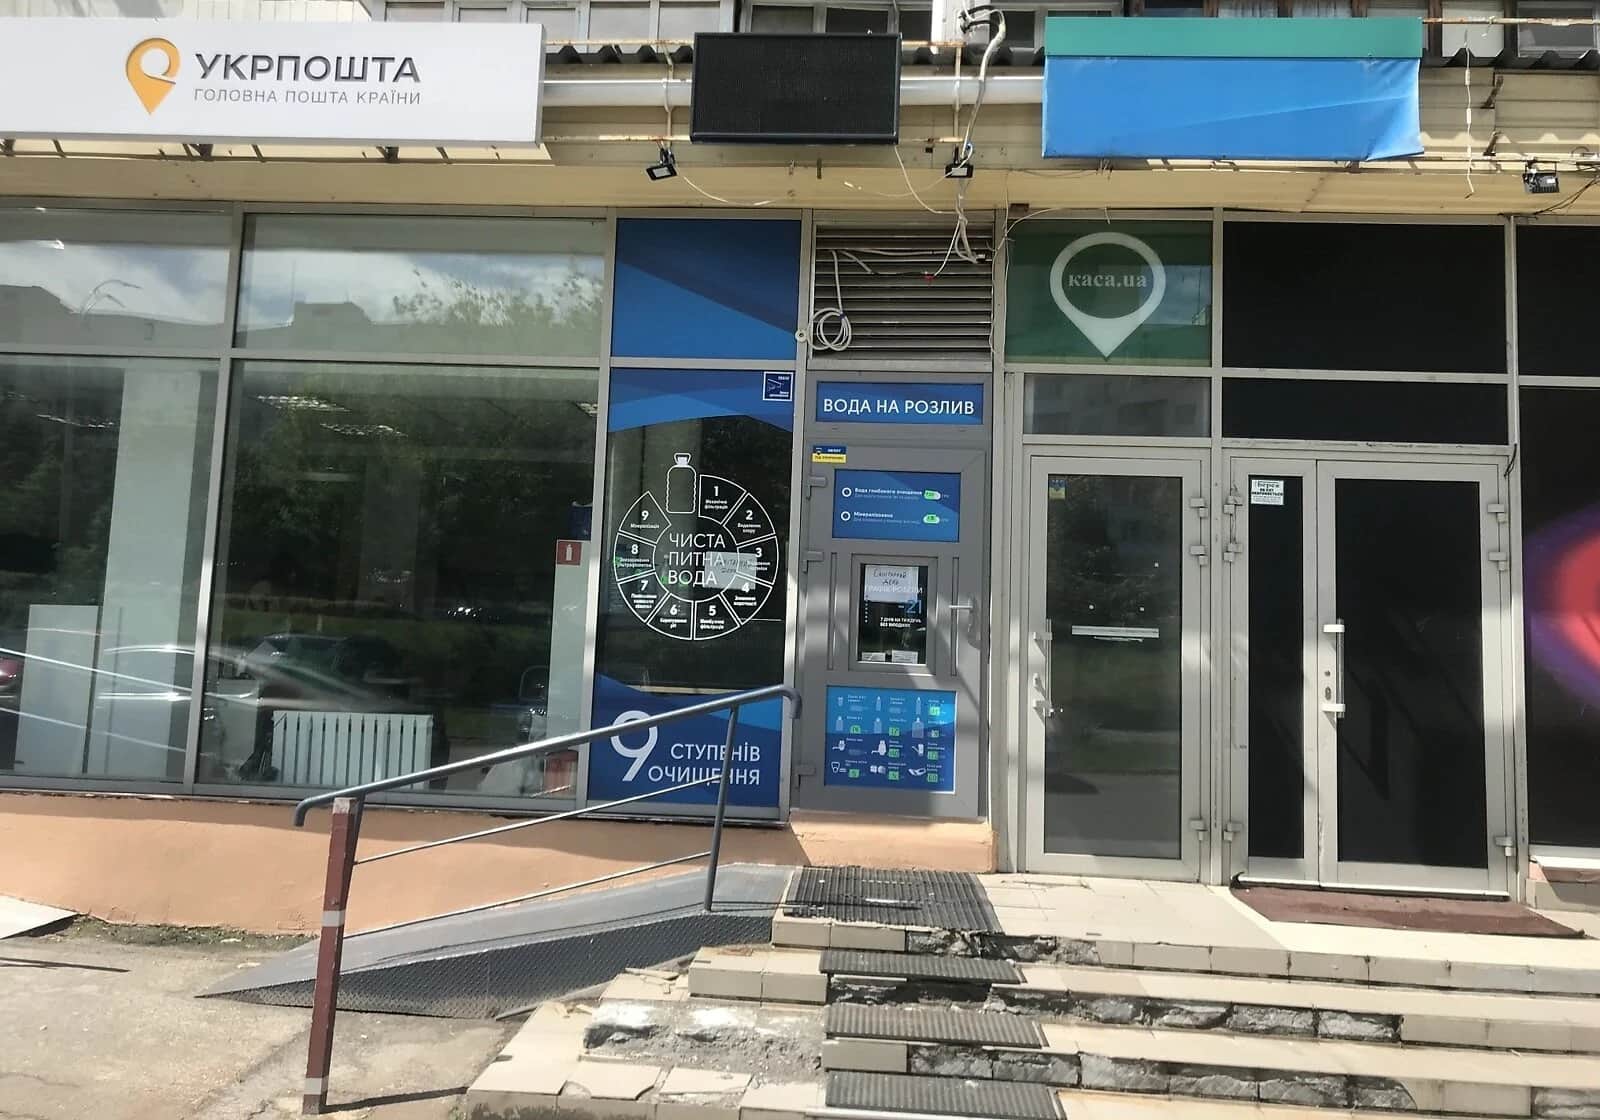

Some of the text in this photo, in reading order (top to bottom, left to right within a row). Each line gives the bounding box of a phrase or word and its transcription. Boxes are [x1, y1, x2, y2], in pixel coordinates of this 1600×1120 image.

[194, 53, 421, 83] УКРПОШТА
[194, 88, 421, 105] ГОЛОВНА ПОШТА КРАЇНИ
[823, 398, 975, 415] ВОДА НА РОЗЛИВ
[713, 485, 719, 497] 1
[641, 510, 649, 521] 9
[745, 509, 753, 521] 2
[669, 533, 726, 549] ЧИСТА
[631, 543, 639, 555] 8
[755, 547, 763, 558] 3
[668, 551, 726, 567] ПИТНА
[668, 570, 718, 588] ВОДА
[640, 580, 649, 591] 7
[741, 582, 750, 593] 4
[669, 604, 678, 616] 6
[708, 604, 717, 617] 5
[610, 710, 658, 782] 9
